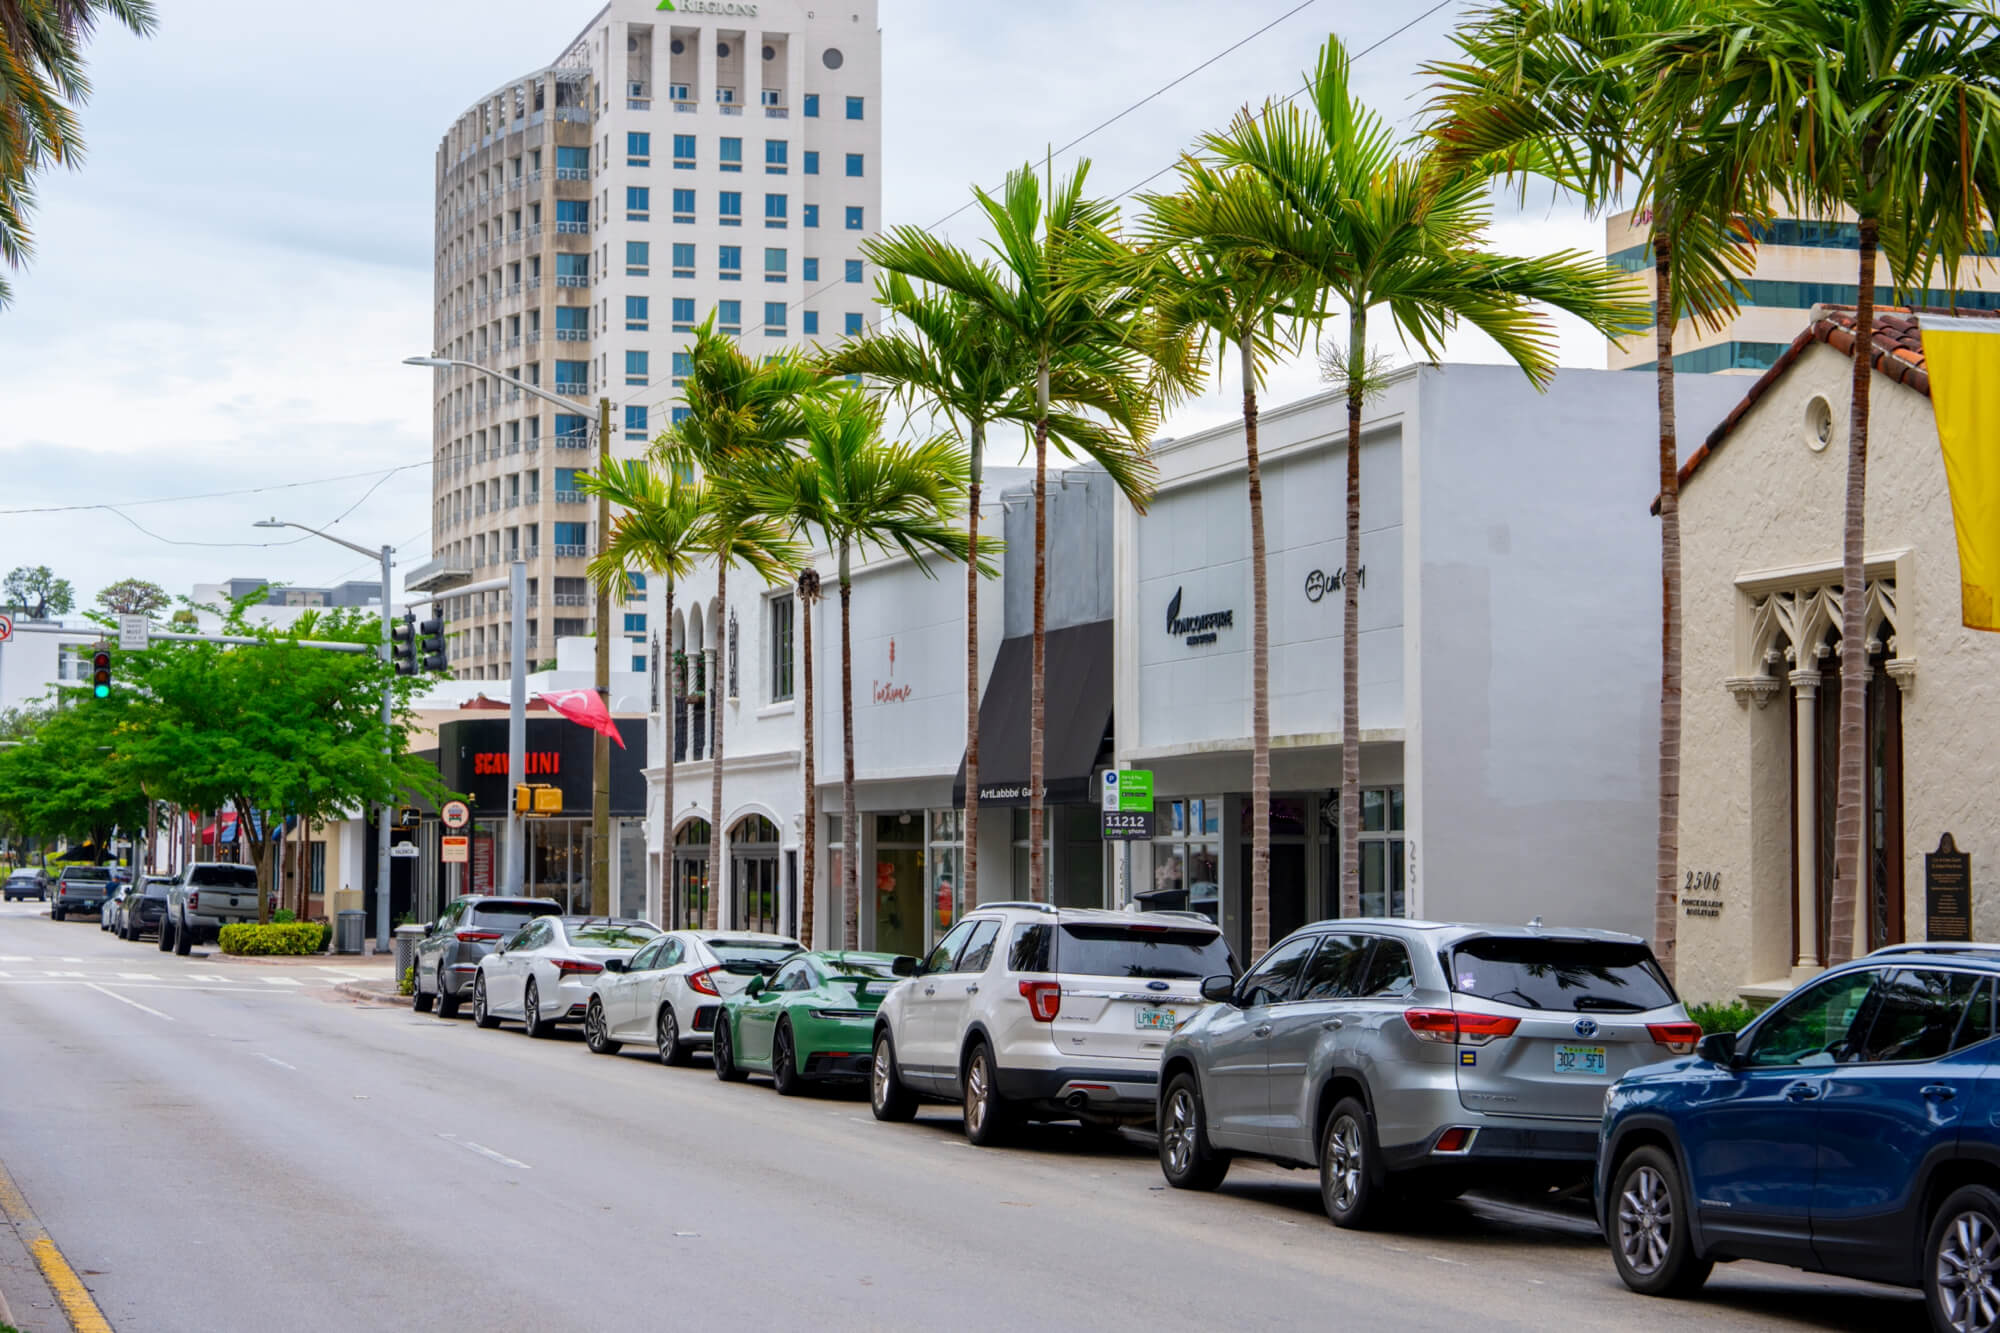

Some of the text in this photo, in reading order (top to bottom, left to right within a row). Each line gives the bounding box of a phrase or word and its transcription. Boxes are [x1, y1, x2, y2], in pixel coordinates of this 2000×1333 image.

[473, 751, 560, 775] SCAVLINI
[1105, 815, 1145, 828] 11212
[1684, 870, 1721, 891] 2506
[1557, 1052, 1575, 1067] 302
